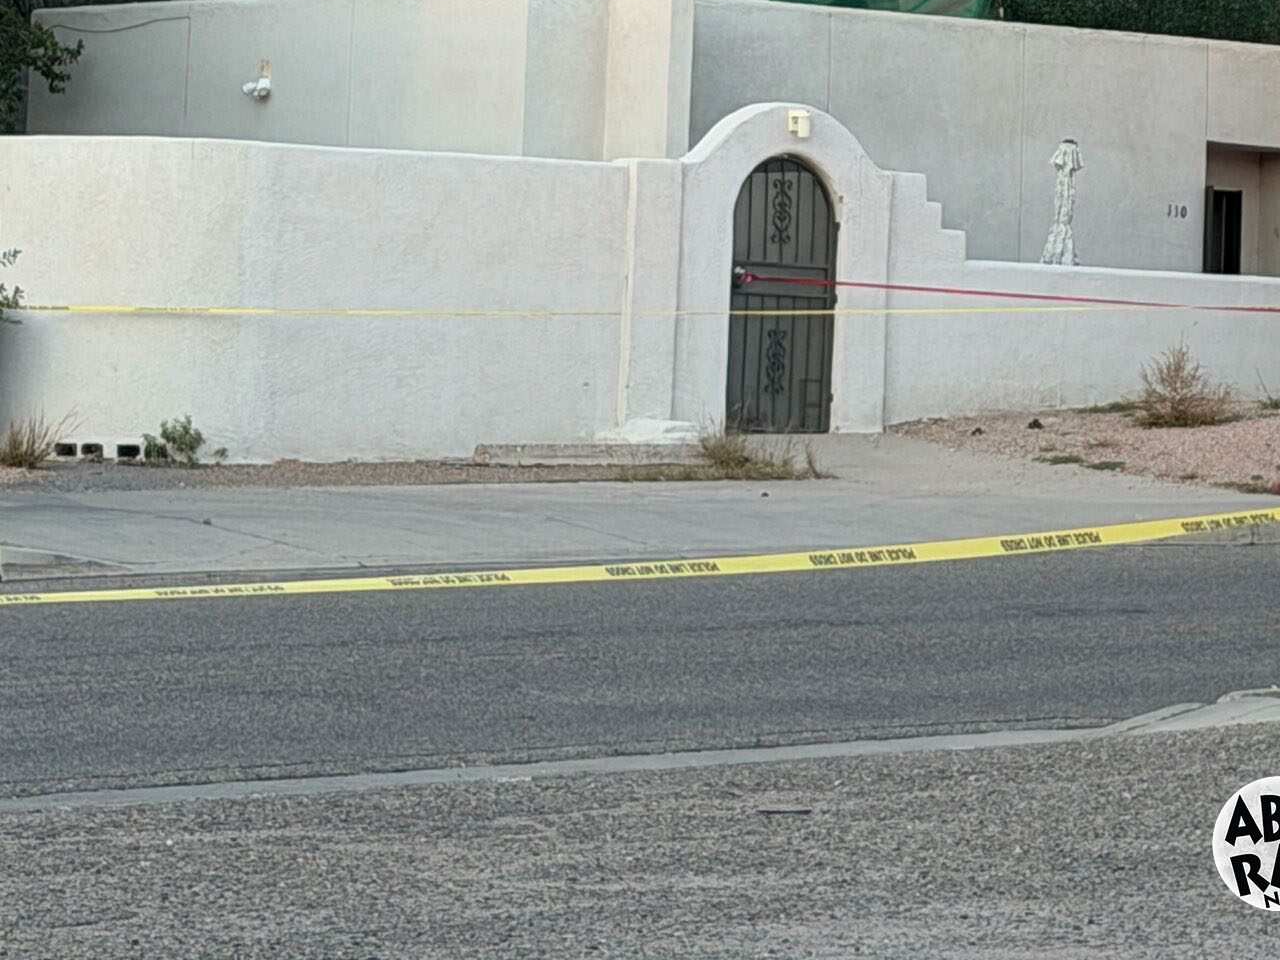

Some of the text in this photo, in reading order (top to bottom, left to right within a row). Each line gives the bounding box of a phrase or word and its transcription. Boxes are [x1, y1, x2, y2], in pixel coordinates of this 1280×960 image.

[1167, 204, 1188, 219] 110
[1000, 530, 1103, 552] POLICE LINE DO NOT CROSS
[808, 547, 917, 566] POLICE LINE DO NOT CROSS
[667, 562, 690, 574] LINE
[686, 560, 721, 573] POLICE
